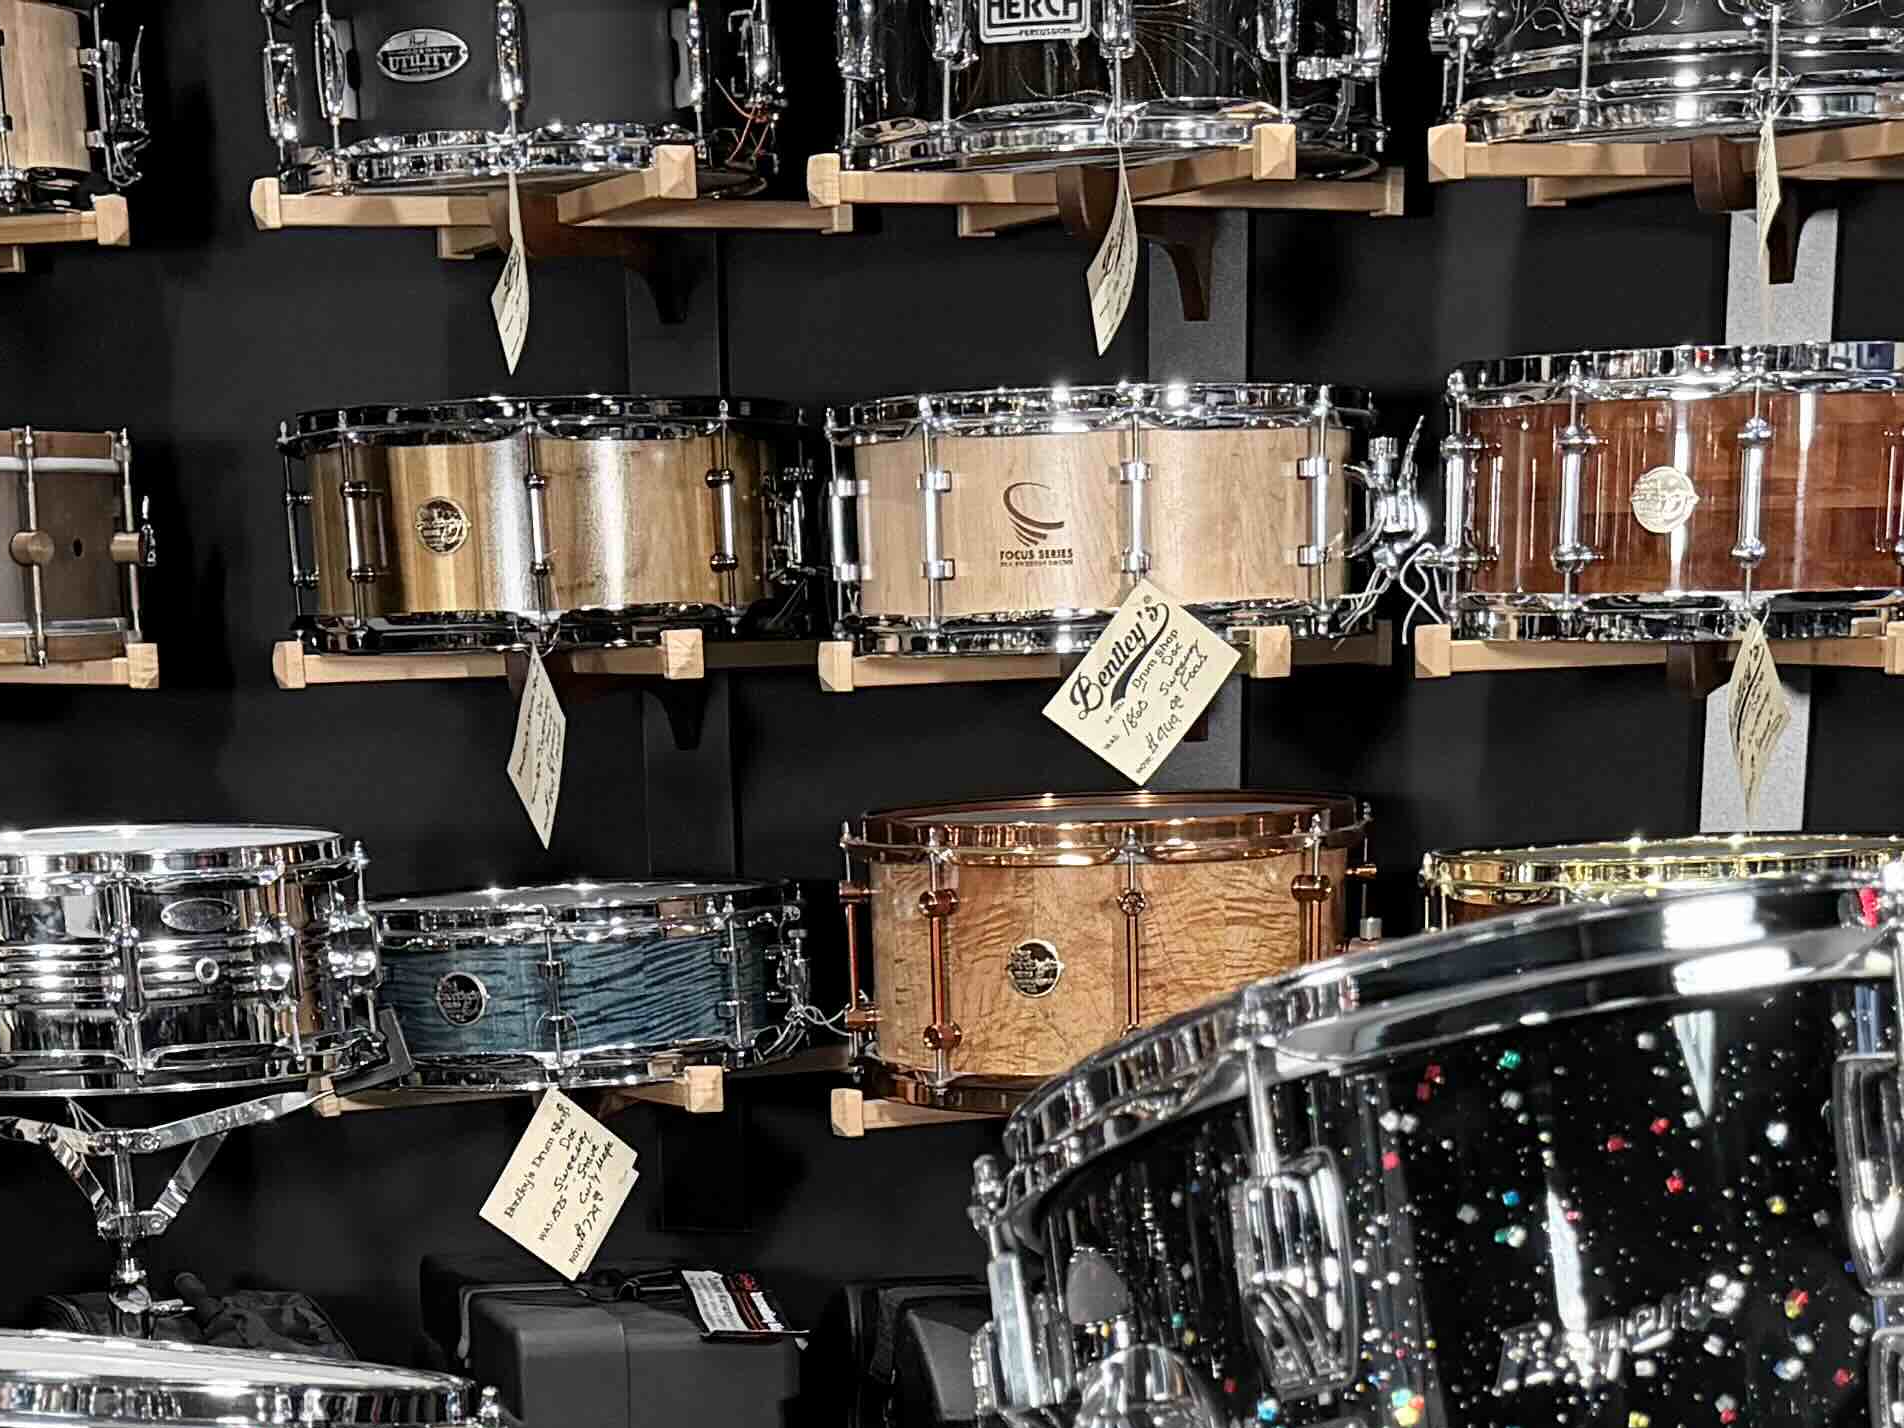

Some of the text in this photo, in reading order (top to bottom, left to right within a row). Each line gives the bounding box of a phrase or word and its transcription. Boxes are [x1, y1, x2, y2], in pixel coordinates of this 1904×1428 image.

[387, 51, 454, 73] UTILITY
[999, 548, 1074, 561] FOCUS SERIES
[1069, 602, 1168, 721] Bentley's
[1131, 628, 1179, 690] Drum Shop
[531, 1136, 554, 1169] Drum
